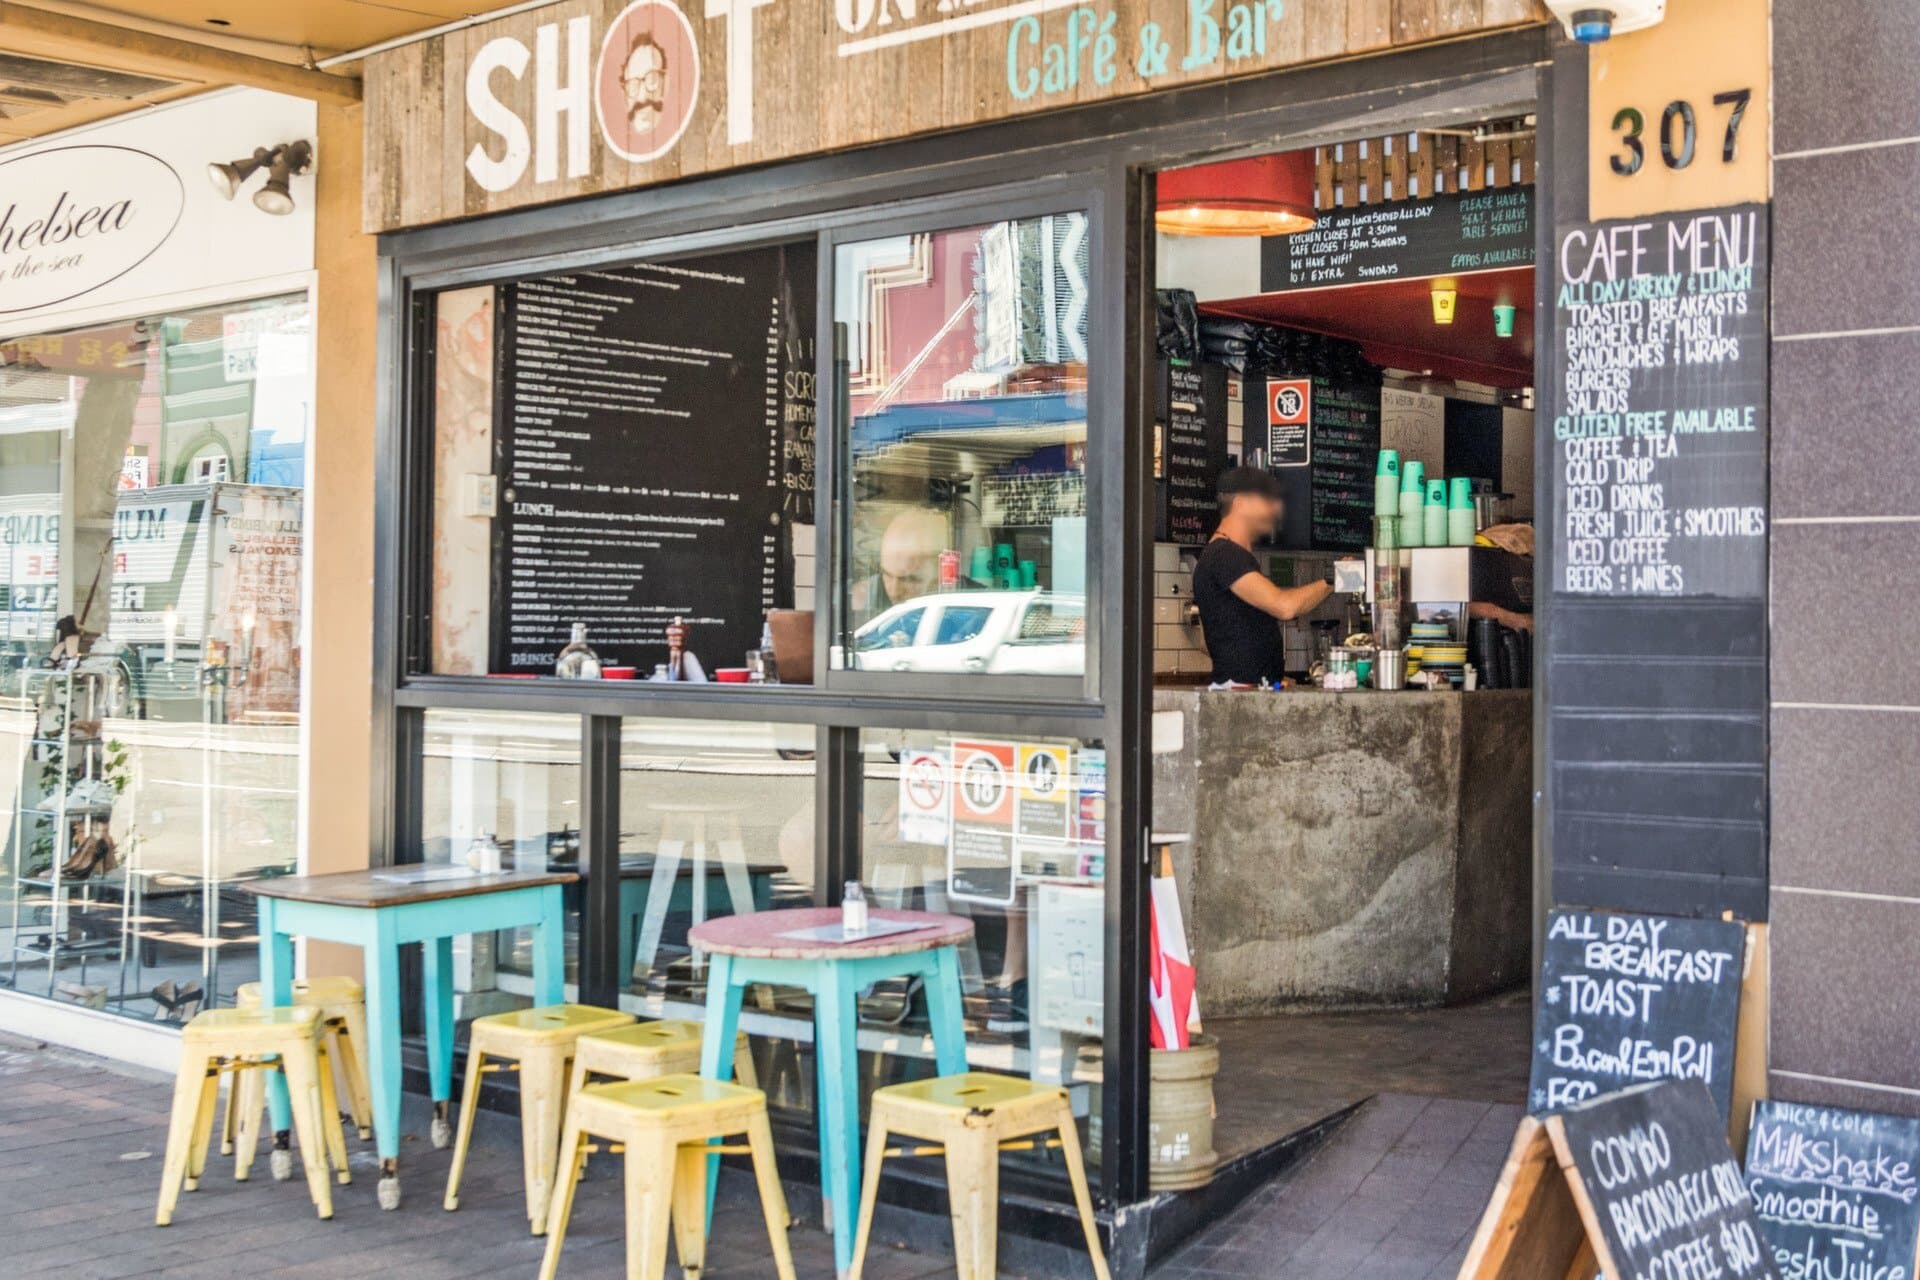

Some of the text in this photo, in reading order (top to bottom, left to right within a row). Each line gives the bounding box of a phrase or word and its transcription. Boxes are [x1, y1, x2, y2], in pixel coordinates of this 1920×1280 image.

[1007, 0, 1285, 99] Café & Bar
[466, 0, 776, 191] SHOT
[1610, 88, 1752, 176] 307
[1400, 208, 1414, 220] ALL
[1415, 205, 1433, 218] DAY
[1289, 231, 1321, 245] KITCHEN
[1323, 229, 1348, 242] CLOSES
[1352, 226, 1363, 238] AT
[1312, 241, 1338, 254] CLOSES
[1371, 236, 1407, 249] SUNDAYS
[1561, 211, 1755, 285] CAFE MENU
[1305, 256, 1325, 269] HAVE
[1358, 264, 1398, 277] SUNDAYS
[1558, 284, 1588, 307] ALL
[1592, 279, 1625, 304] DAY
[1628, 273, 1682, 300] BREKKY
[1700, 267, 1752, 294] LUNCH
[1566, 291, 1747, 328] TOASTED BREAKFASTS
[1566, 323, 1630, 350] BIRCHER
[1567, 344, 1664, 371] SANDWICHES
[1685, 337, 1739, 364] WRAPS
[1566, 368, 1631, 393] BURGERS
[1566, 389, 1629, 416] SALADS
[1554, 406, 1755, 440] GLUTEN FREE AVAILABLE
[1565, 436, 1623, 461] COFFEE
[1644, 434, 1678, 458] TEA
[1566, 458, 1654, 485] COLD DRIP
[512, 502, 554, 517] LUNCH
[1567, 484, 1664, 512] ICED DRINKS
[1566, 510, 1615, 538] FRESH
[1623, 509, 1671, 538] JUICE
[1684, 506, 1765, 537] SMOOTHIES
[1568, 537, 1669, 565] ICED COFFEE
[1566, 566, 1612, 592] BEERS
[1632, 565, 1683, 592] WINES
[511, 653, 554, 666] DRINKS
[1548, 915, 1668, 948] ALL DAY
[1584, 941, 1733, 984] BREAKFAST
[1560, 975, 1662, 1023] TOAST
[1590, 1121, 1671, 1190] COMBO
